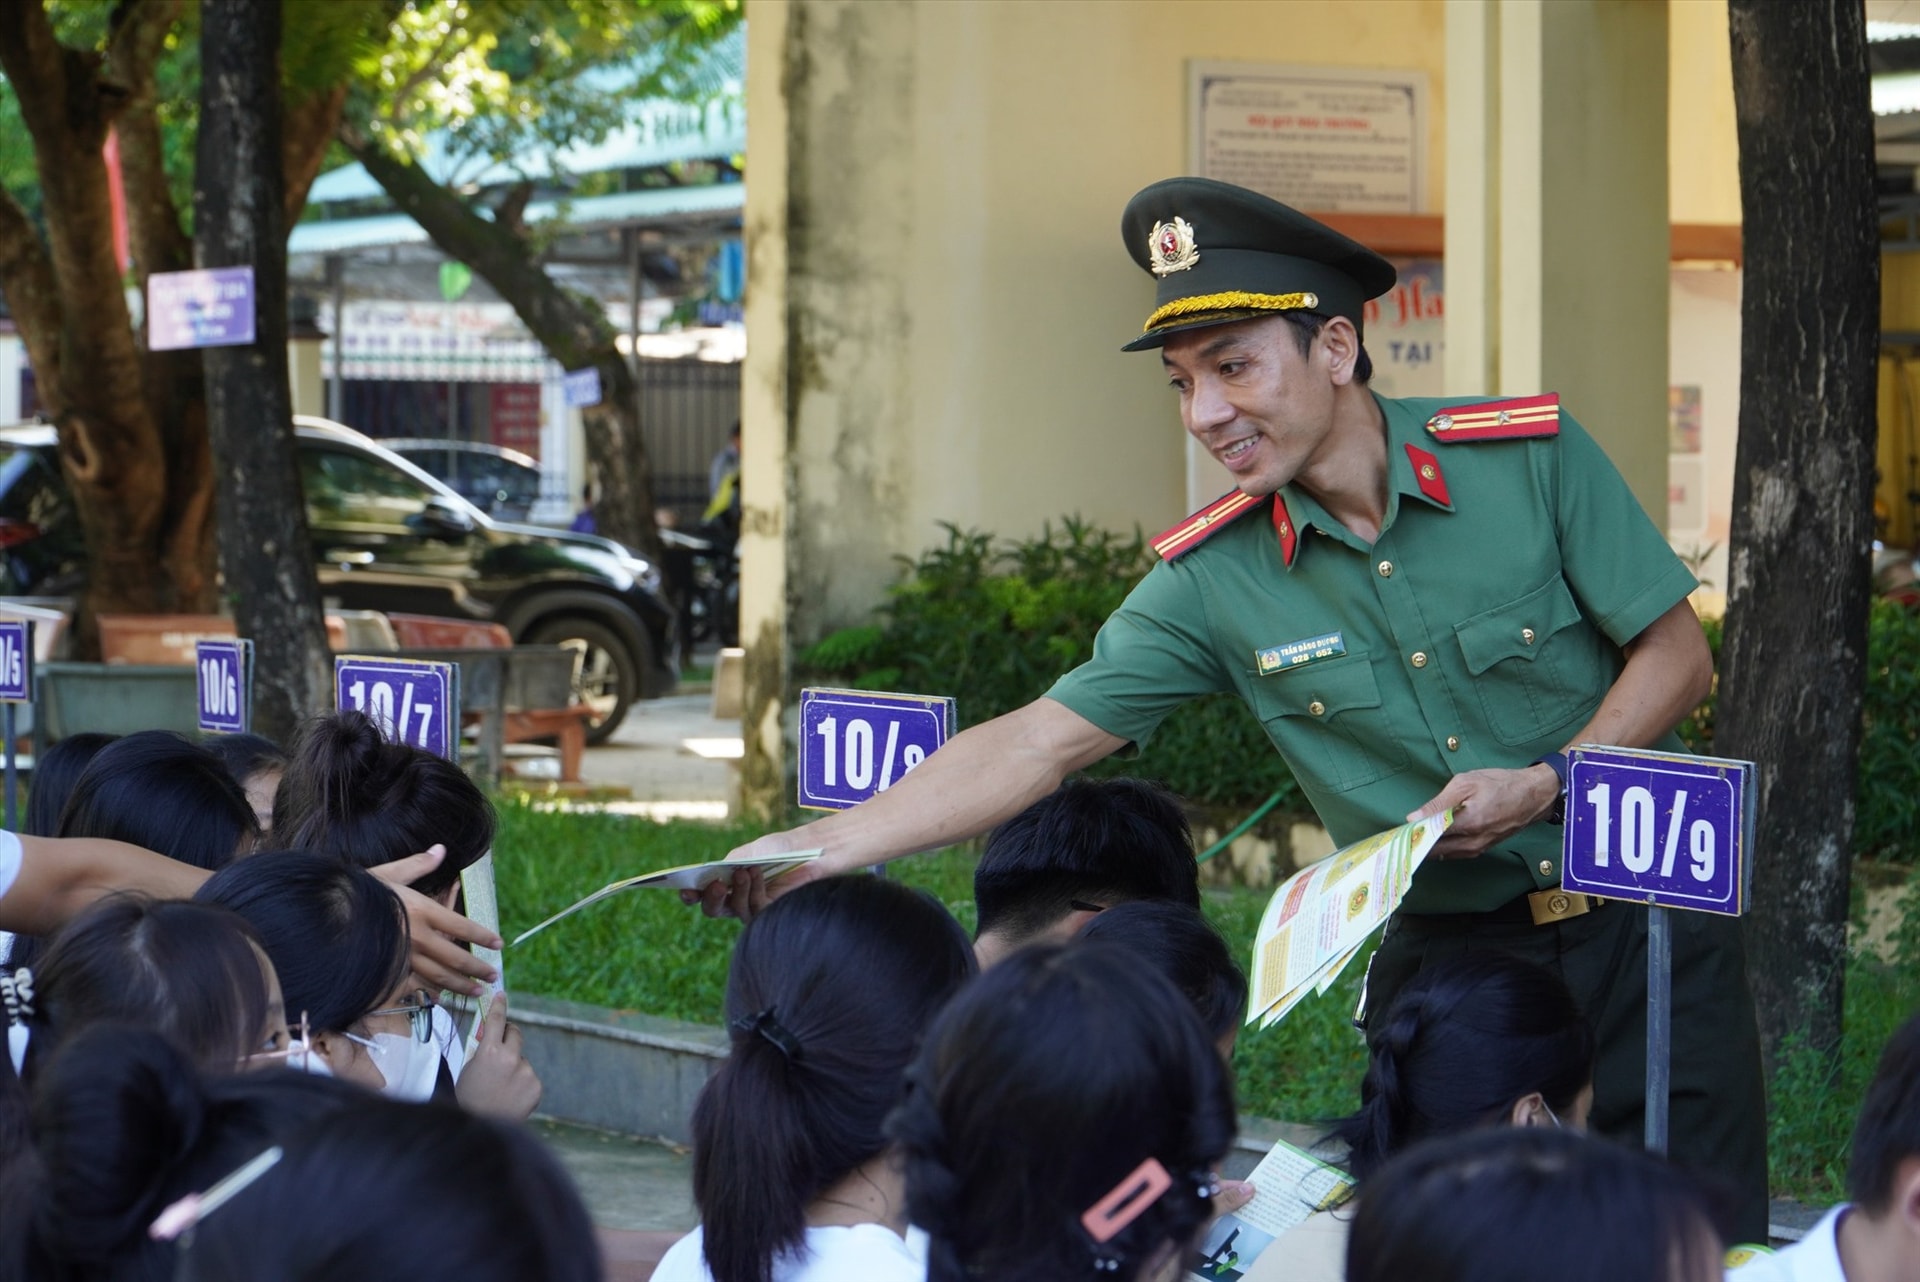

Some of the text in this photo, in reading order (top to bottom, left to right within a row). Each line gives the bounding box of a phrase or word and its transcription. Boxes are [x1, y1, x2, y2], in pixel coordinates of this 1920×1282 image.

[1389, 341, 1432, 369] TẠI
[202, 658, 237, 716] 10/6
[349, 681, 433, 748] 10/7
[1587, 782, 1716, 882] 10/9
